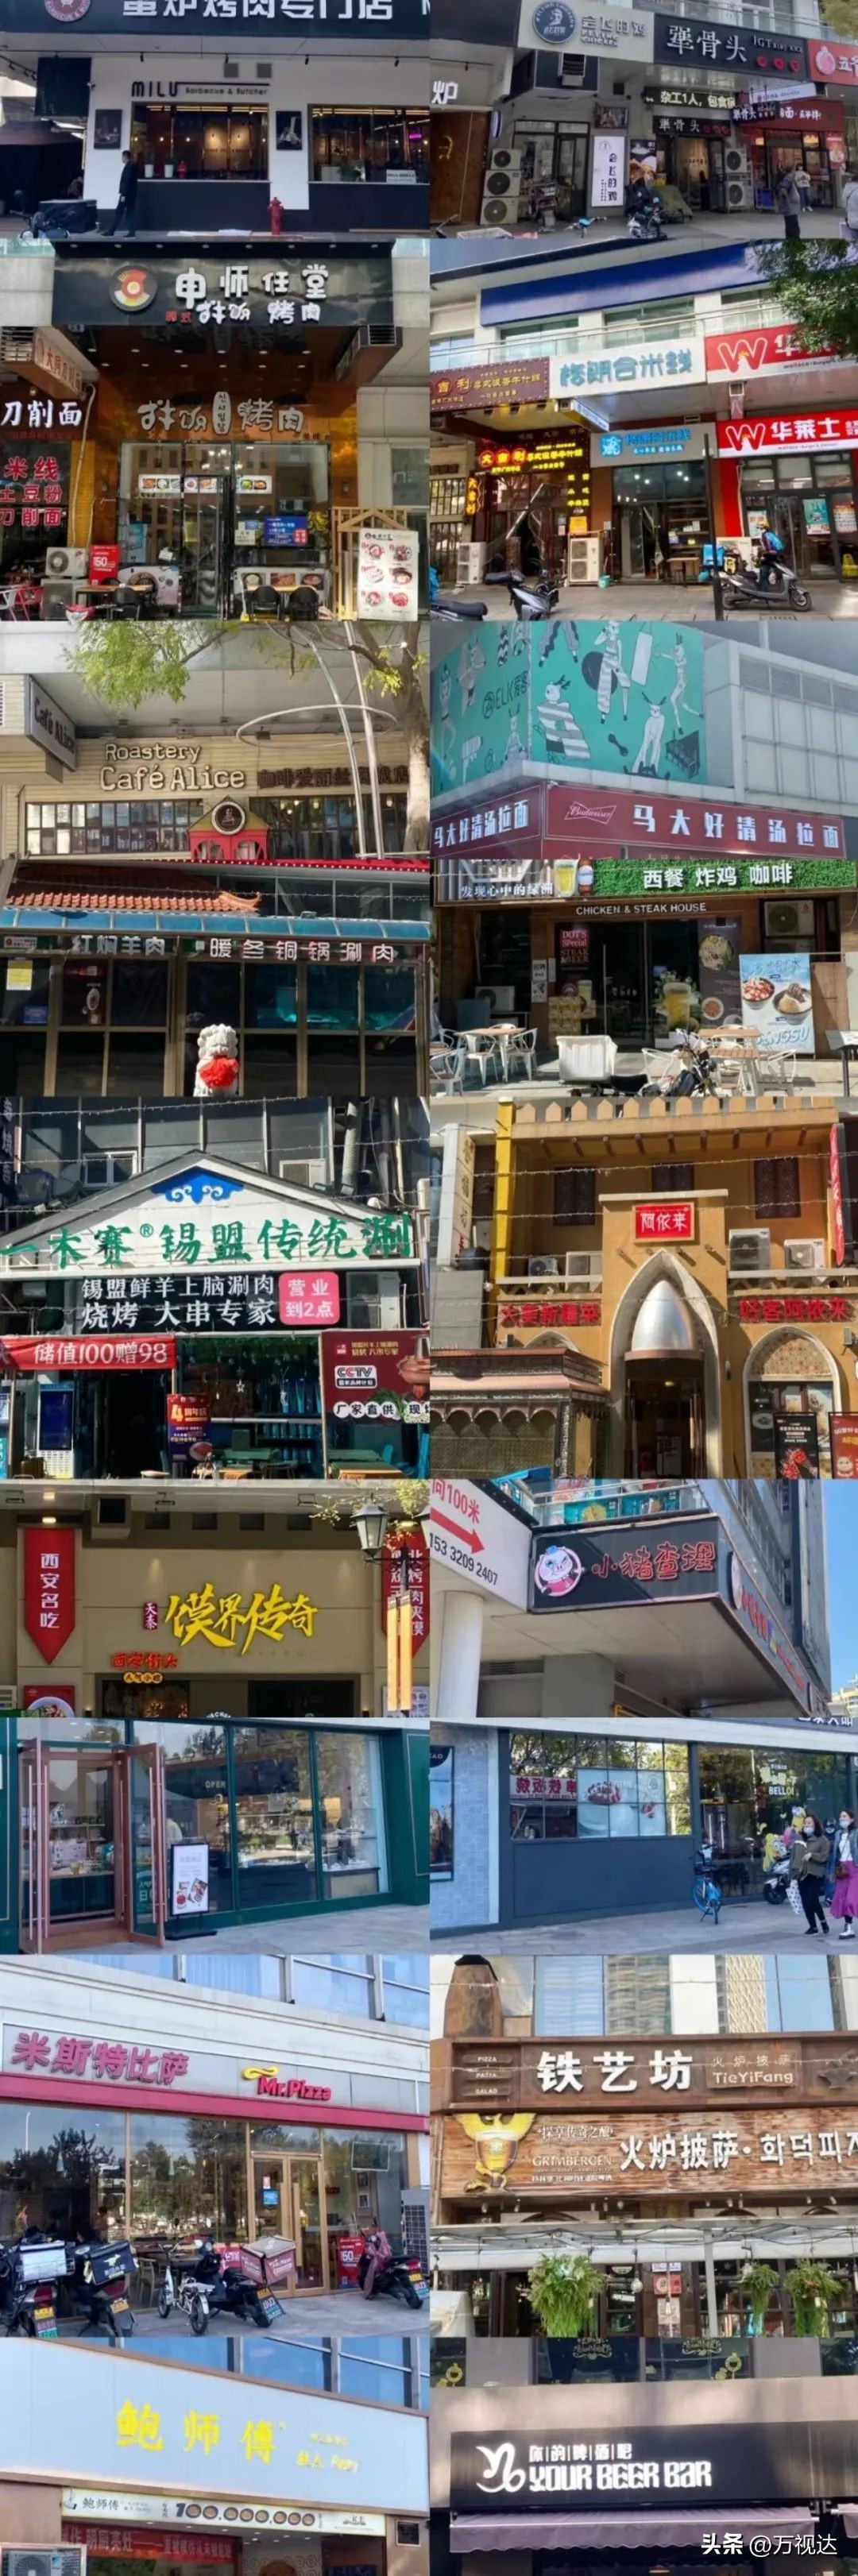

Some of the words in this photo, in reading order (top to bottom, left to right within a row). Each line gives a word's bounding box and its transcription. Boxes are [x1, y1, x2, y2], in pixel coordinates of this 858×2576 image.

[132, 81, 179, 97] MILU
[176, 264, 329, 310] 申师任堂
[268, 299, 321, 325] 烤肉
[771, 417, 841, 441] 华莱士
[5, 457, 60, 481] 米线
[0, 485, 62, 503] 土豆粉
[0, 508, 62, 526] 刀削面
[105, 743, 202, 763] Roastery
[100, 764, 164, 791] Café
[170, 765, 246, 791] Alice
[434, 799, 529, 849] 马大好清汤拉面
[633, 804, 840, 848] 马大好清汤拉面
[644, 868, 683, 889] 西餐
[696, 867, 737, 886] 炸鸡
[750, 863, 794, 885] 咖啡
[462, 882, 554, 898] 发现心中的绿洲
[576, 906, 621, 916] CHICKEN
[624, 906, 632, 915] &
[634, 904, 667, 914] STEAK
[671, 902, 707, 913] HOUSE
[72, 935, 165, 956] 红焖羊肉
[210, 937, 394, 963] 暖冬铜锅涮肉
[640, 1212, 688, 1233] 阿依来
[82, 1274, 276, 1300] 锡盟鲜羊上脑涮肉
[288, 1279, 329, 1298] 营业
[82, 1303, 140, 1330] 烧烤
[153, 1300, 277, 1328] 大串专家
[284, 1301, 336, 1319] 到2点
[34, 1340, 168, 1366] 储值100赠98
[337, 1367, 373, 1377] CCTV
[336, 1404, 394, 1415] 厂家直供
[430, 1532, 448, 1556] 153
[450, 1545, 475, 1572] 3209
[477, 1562, 499, 1585] 2407
[591, 1541, 715, 1580] 小猪查理
[40, 1553, 60, 1630] 西安名吃
[164, 1583, 319, 1657] 馍界传奇
[12, 2032, 190, 2087] 米斯特比萨
[537, 2049, 693, 2093] 铁艺坊
[713, 2071, 794, 2084] TieYiFang
[116, 2399, 276, 2465] 鲍师傅
[528, 2463, 593, 2492] YOUR
[597, 2461, 660, 2490] BEER
[83, 2497, 119, 2511] 鲍师傅
